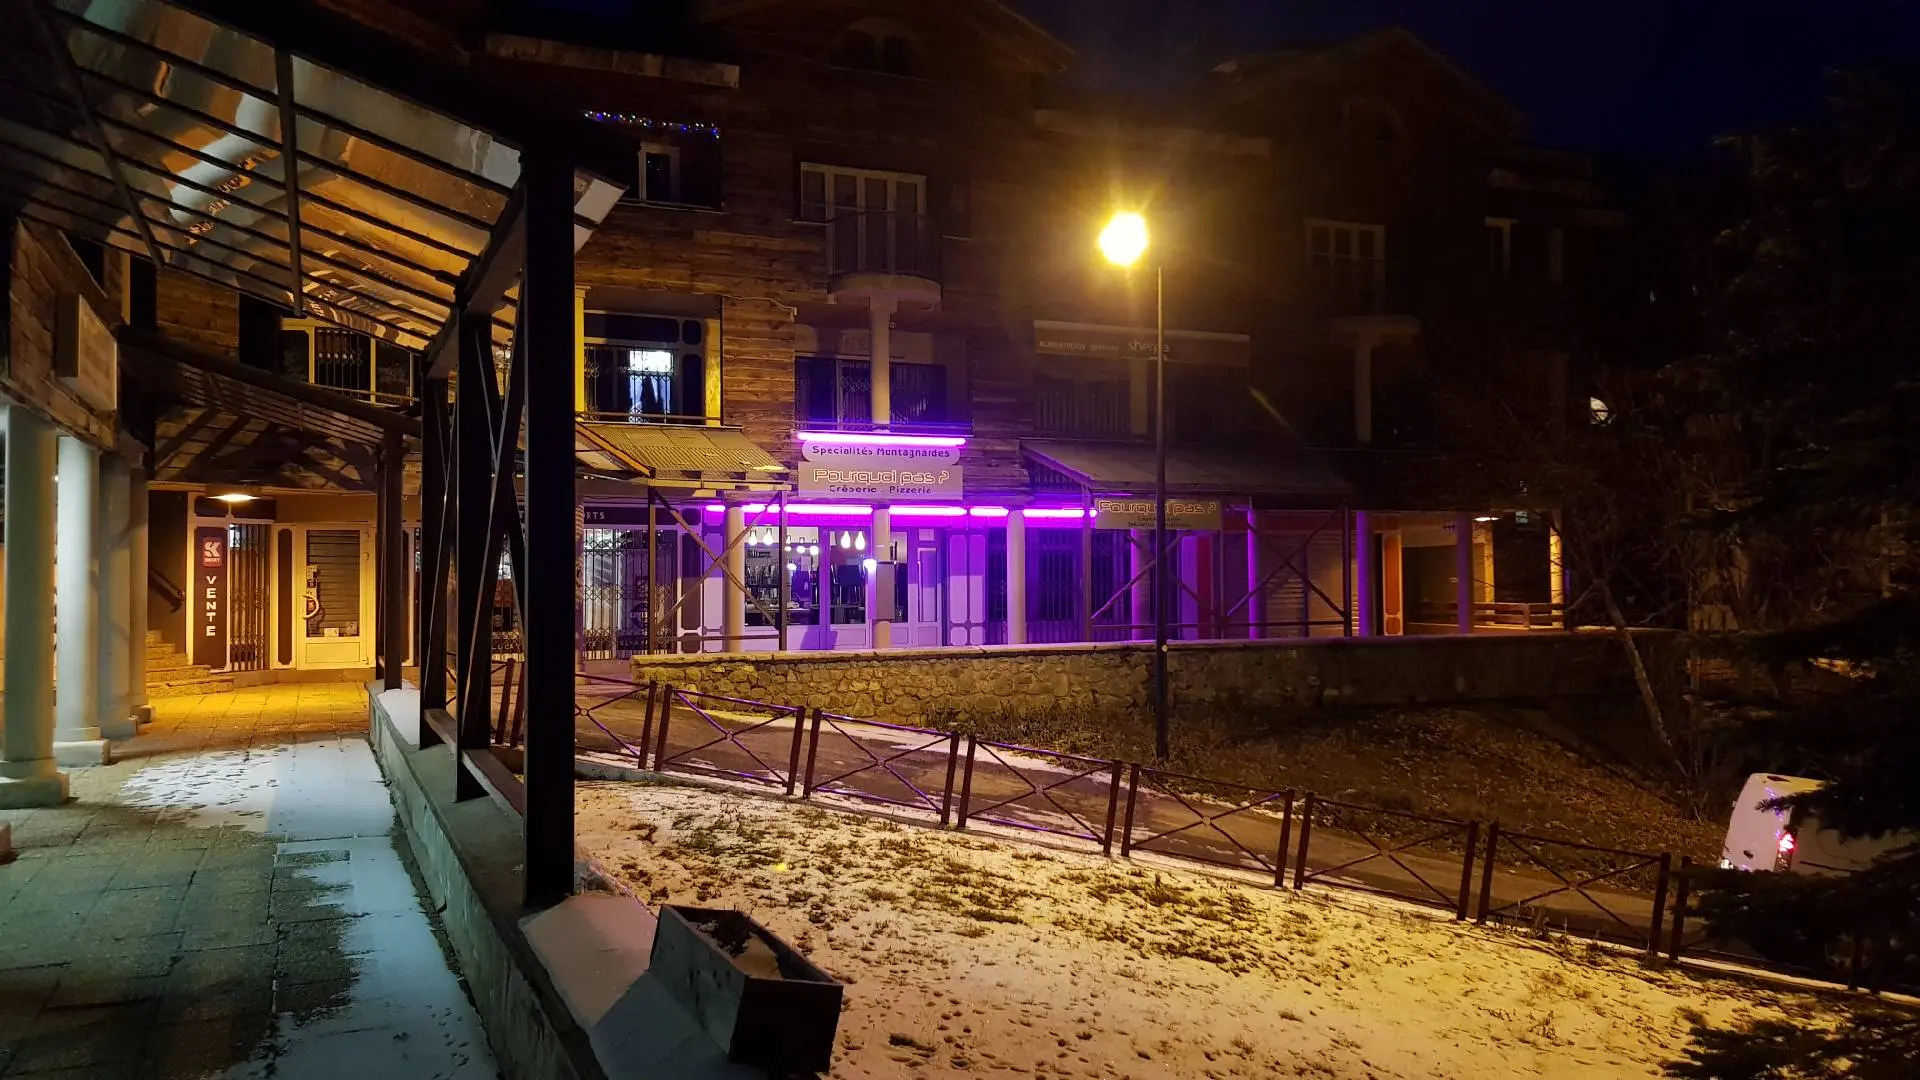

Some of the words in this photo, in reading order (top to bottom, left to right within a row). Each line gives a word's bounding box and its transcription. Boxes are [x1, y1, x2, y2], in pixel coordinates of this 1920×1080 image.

[876, 446, 950, 459] Montagnardes
[813, 468, 897, 485] Pourquoi
[900, 471, 935, 485] pas
[1098, 500, 1171, 516] Pourqui
[205, 575, 217, 637] VENTE
